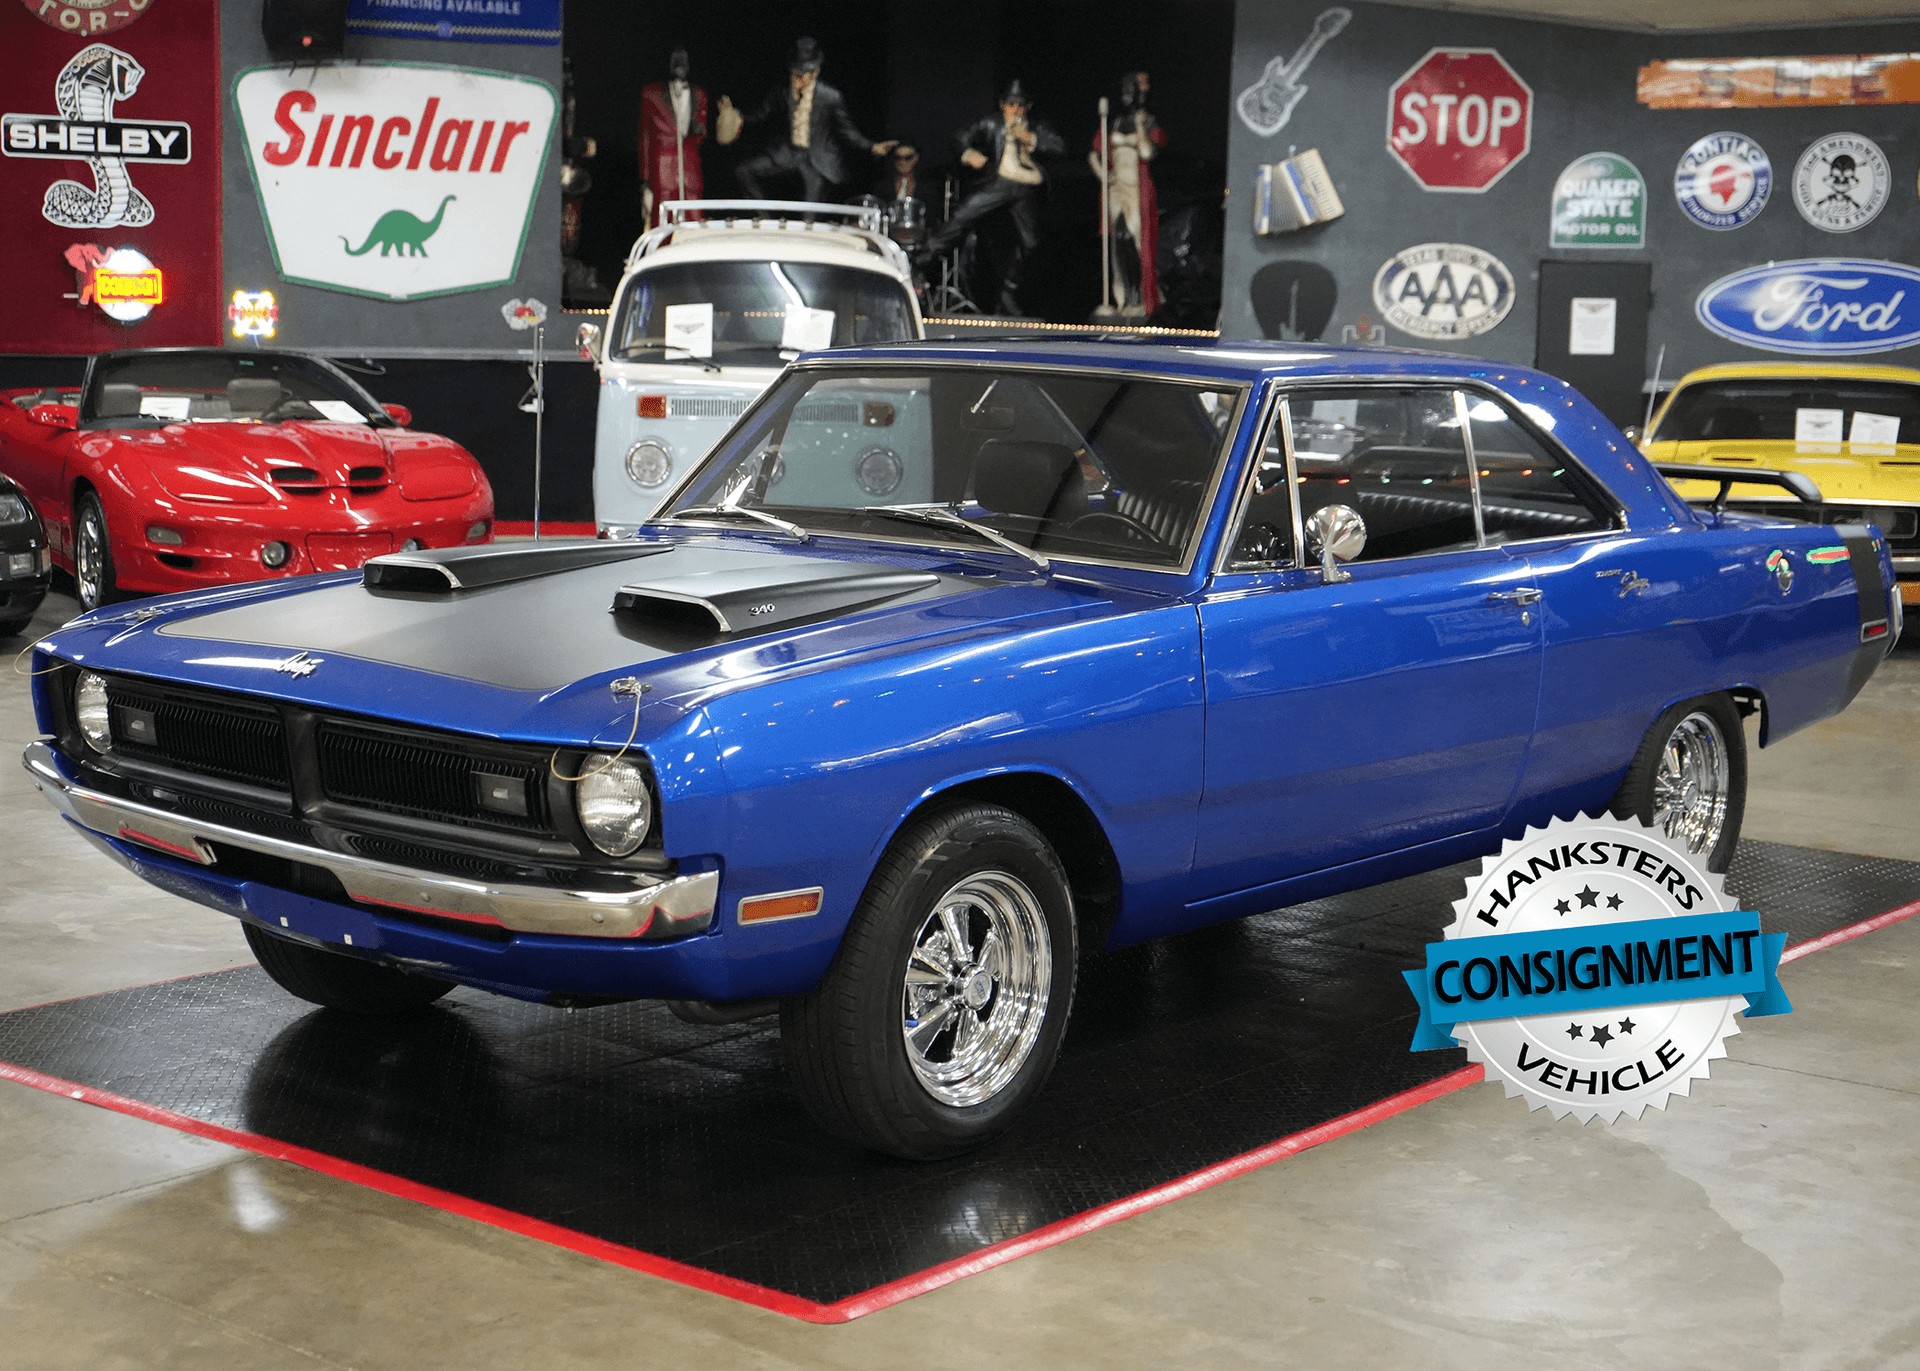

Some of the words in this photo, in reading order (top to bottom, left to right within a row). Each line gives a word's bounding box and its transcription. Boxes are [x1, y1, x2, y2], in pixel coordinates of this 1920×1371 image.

[446, 0, 521, 15] AVAILABLE
[262, 90, 531, 173] Sinclair
[1398, 92, 1522, 147] STOP
[9, 123, 181, 155] SHELBY
[1683, 137, 1763, 171] PONTIAC
[1560, 178, 1640, 198] QUAKER
[1566, 199, 1634, 218] STATE
[1557, 222, 1611, 236] MOTOR
[1614, 222, 1640, 236] OIL
[1398, 264, 1488, 318] AAA
[1753, 274, 1906, 332] Ford
[750, 603, 776, 616] 340
